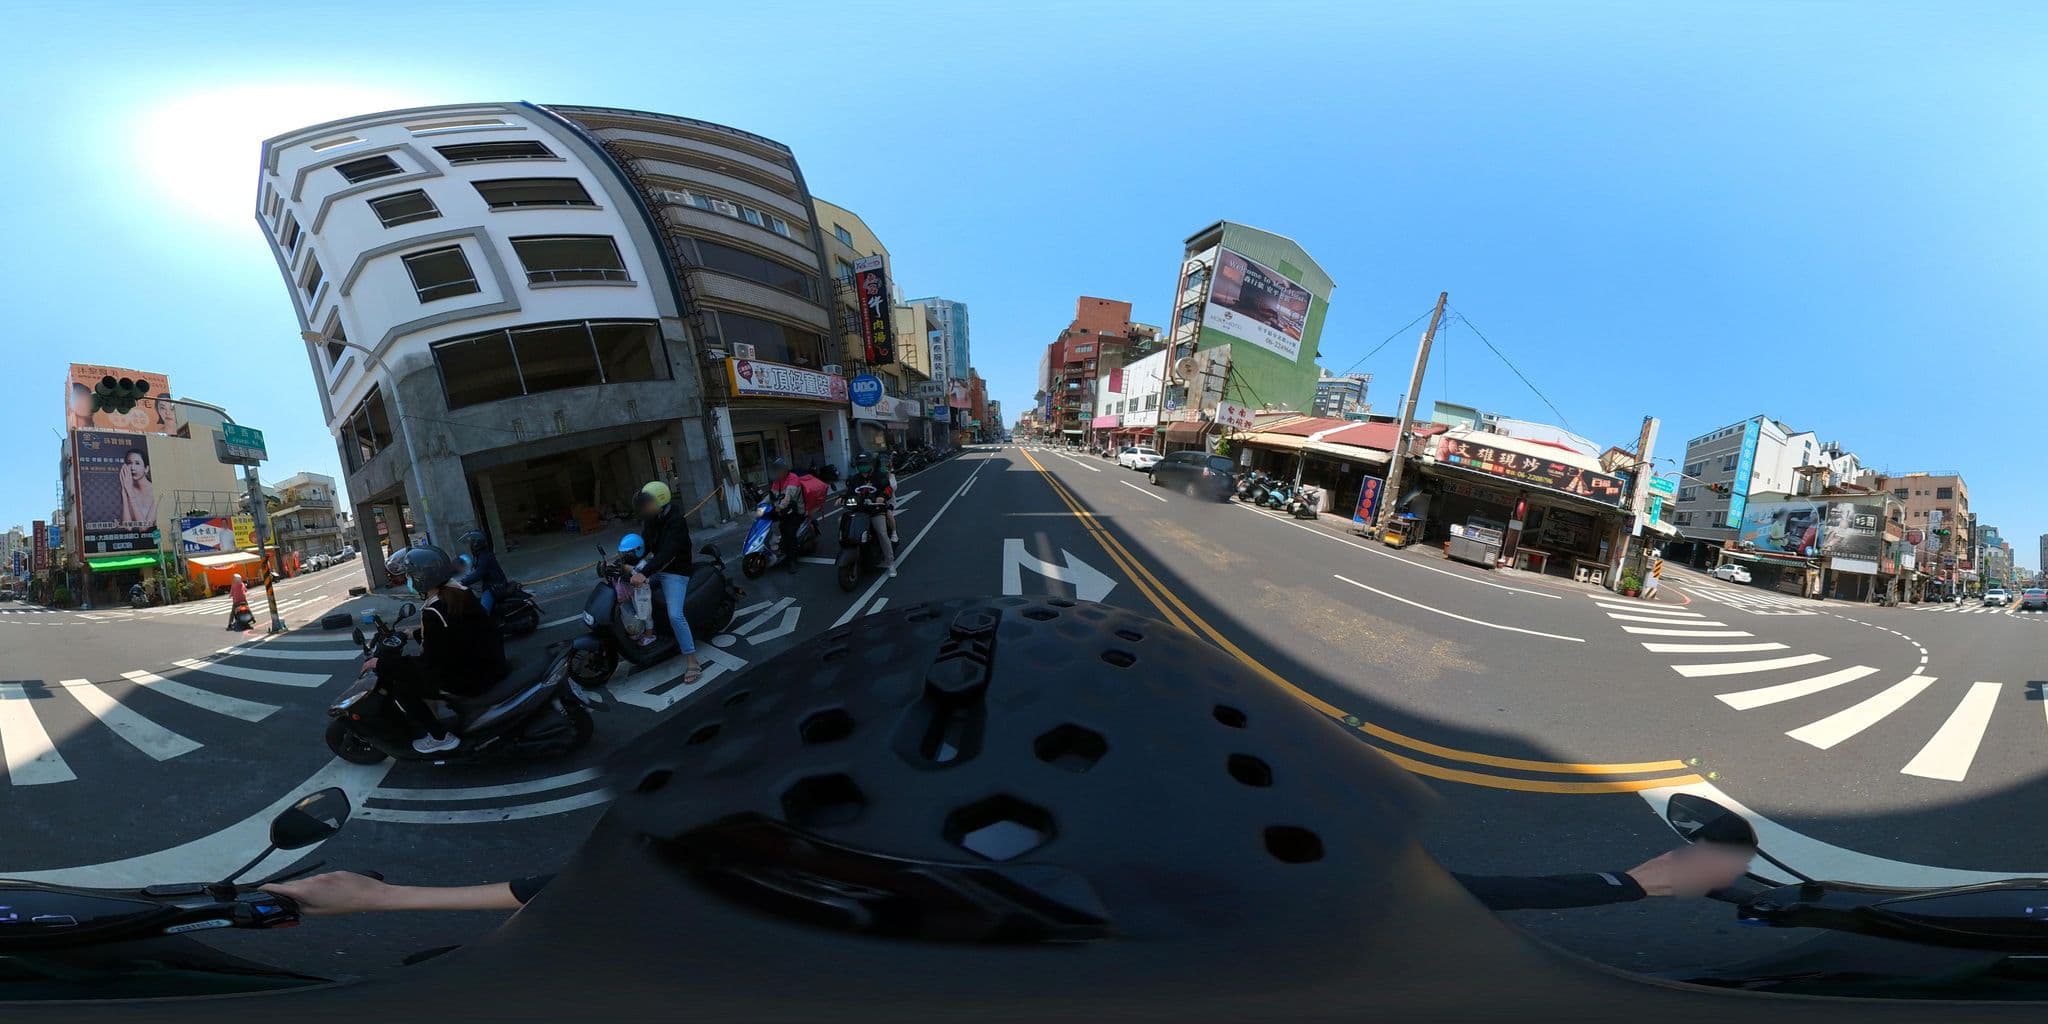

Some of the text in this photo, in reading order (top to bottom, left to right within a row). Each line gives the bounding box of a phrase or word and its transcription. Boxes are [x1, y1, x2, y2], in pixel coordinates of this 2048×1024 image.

[1230, 261, 1262, 280] Welcome
[1264, 276, 1271, 284] to
[771, 366, 830, 396] 頂好童裝
[1456, 443, 1541, 473] 文雄現炒
